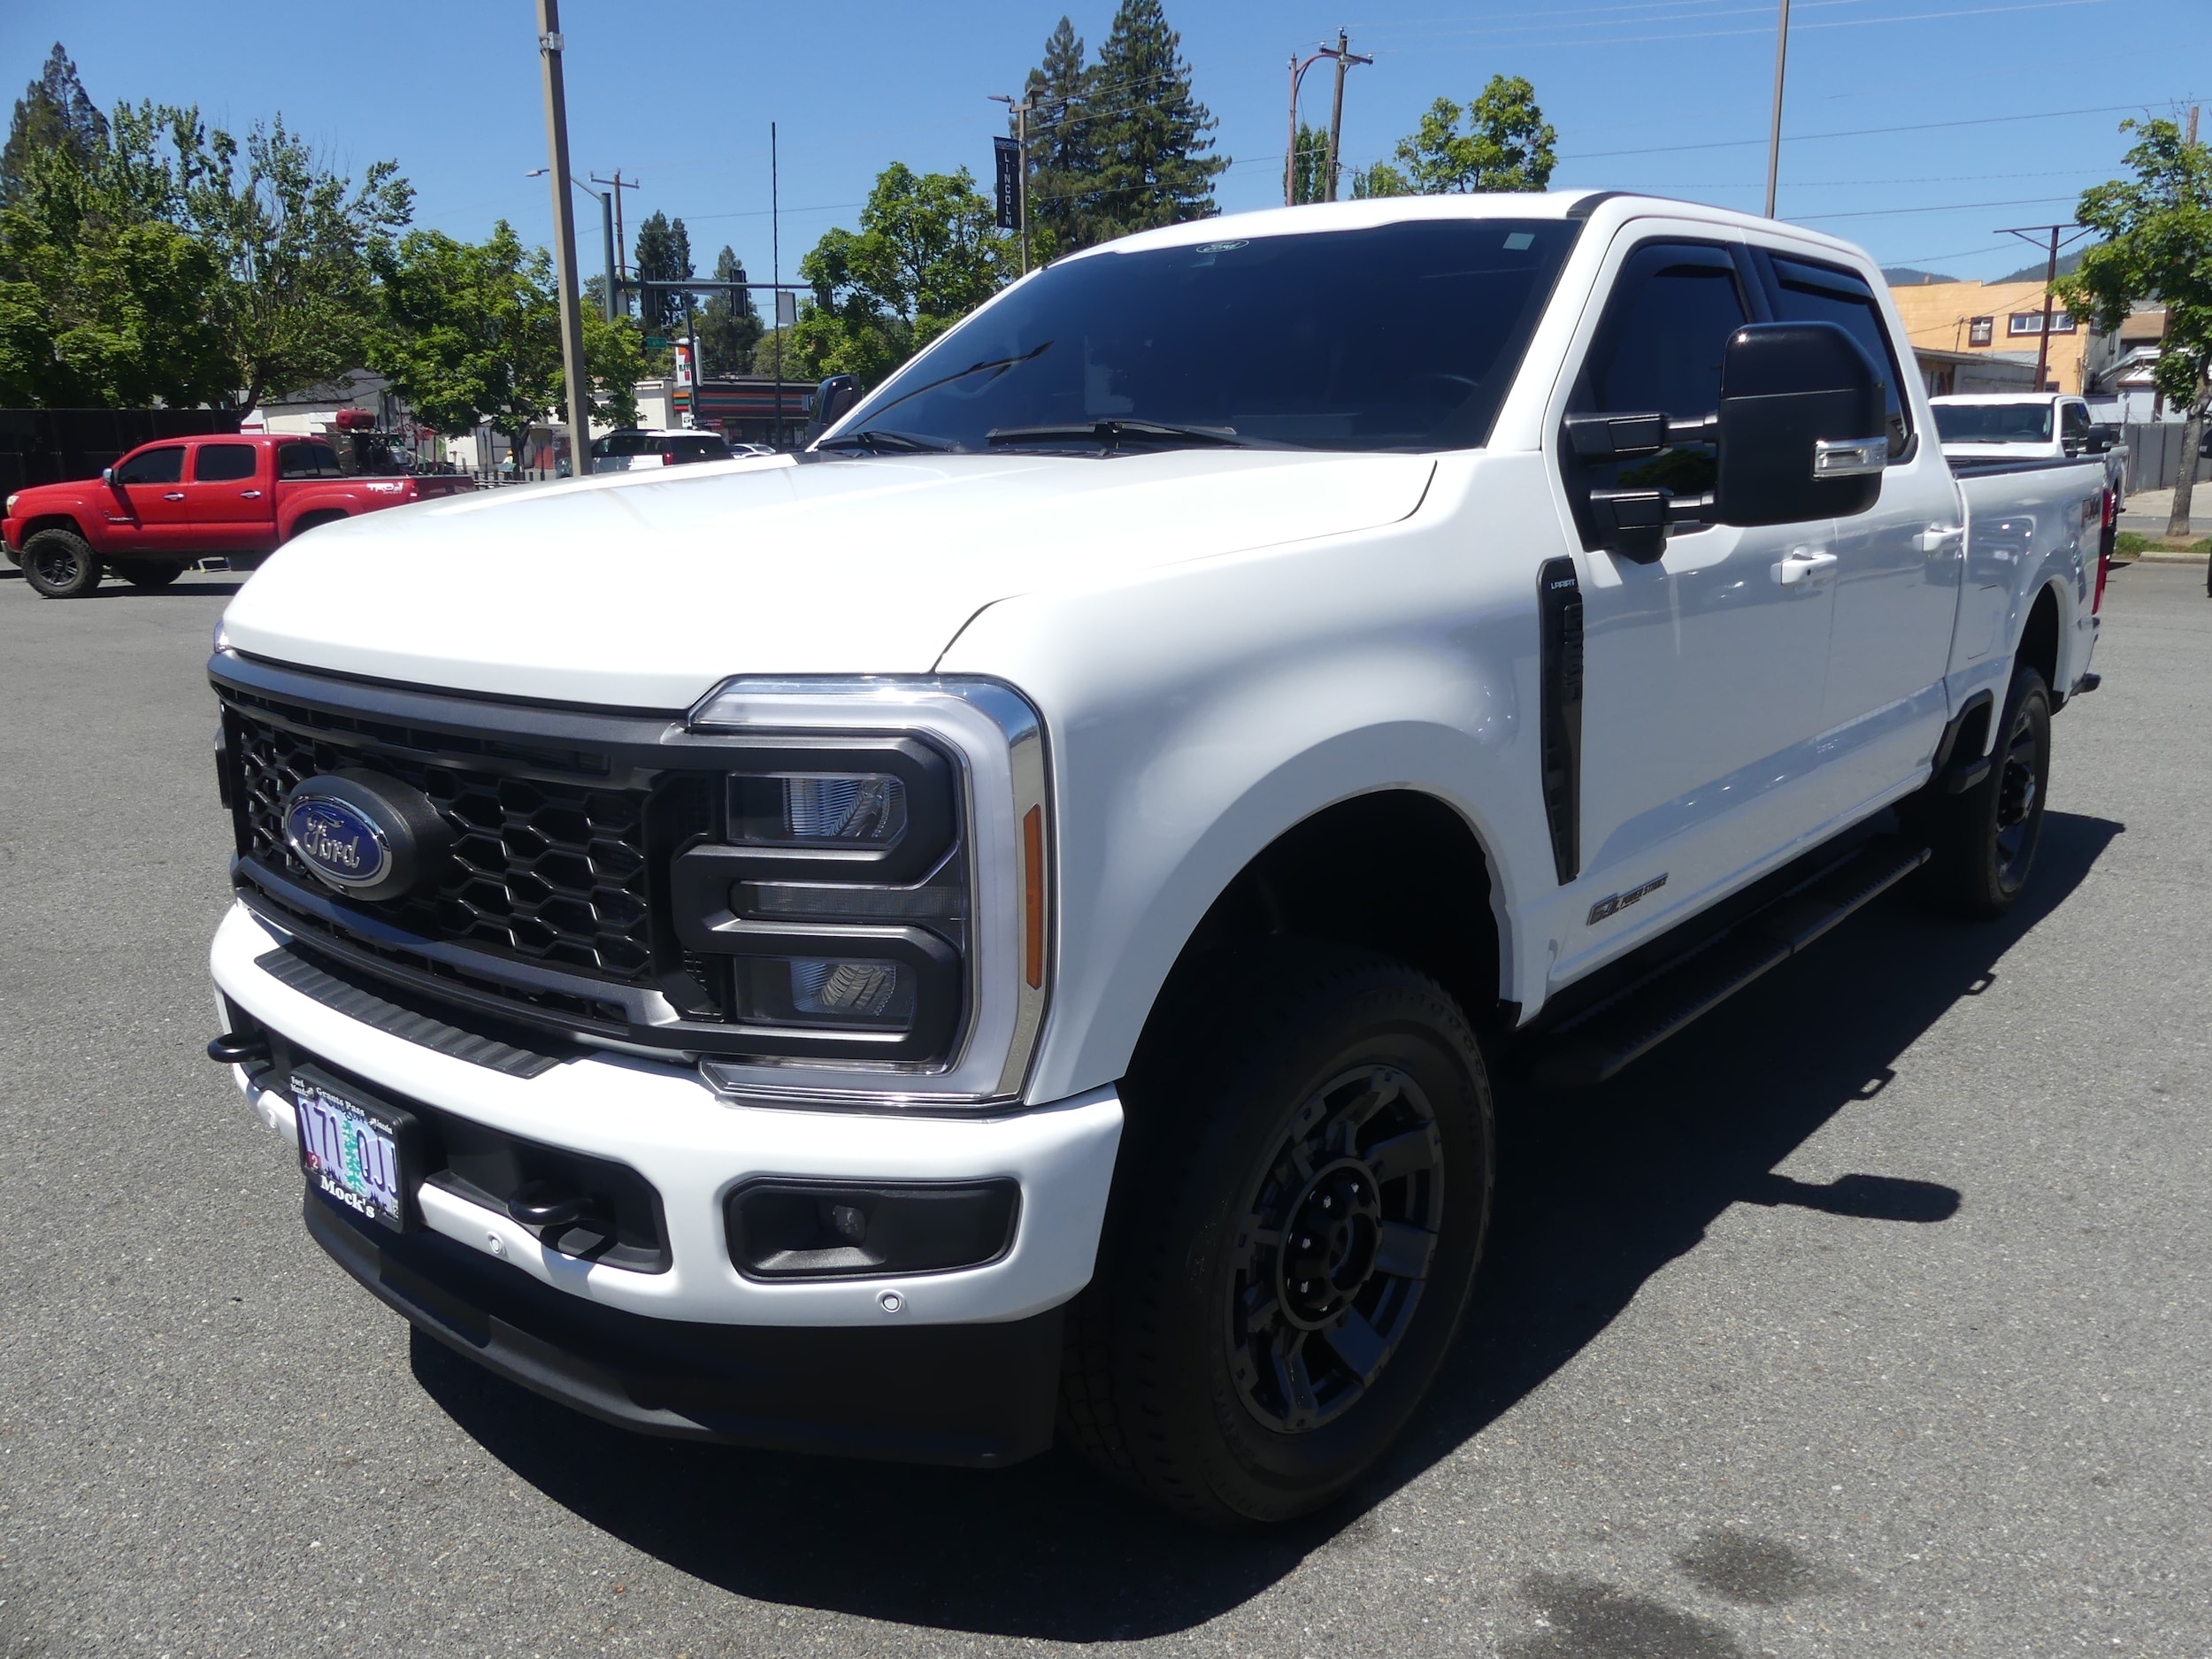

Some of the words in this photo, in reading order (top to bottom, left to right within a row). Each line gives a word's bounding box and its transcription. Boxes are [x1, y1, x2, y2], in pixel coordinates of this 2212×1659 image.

[1003, 152, 1012, 226] LINCOLN
[366, 482, 394, 492] TRD
[303, 810, 360, 869] Ford
[316, 1087, 344, 1106] Grants
[345, 1101, 365, 1117] Pass
[320, 1175, 375, 1219] Mock's
